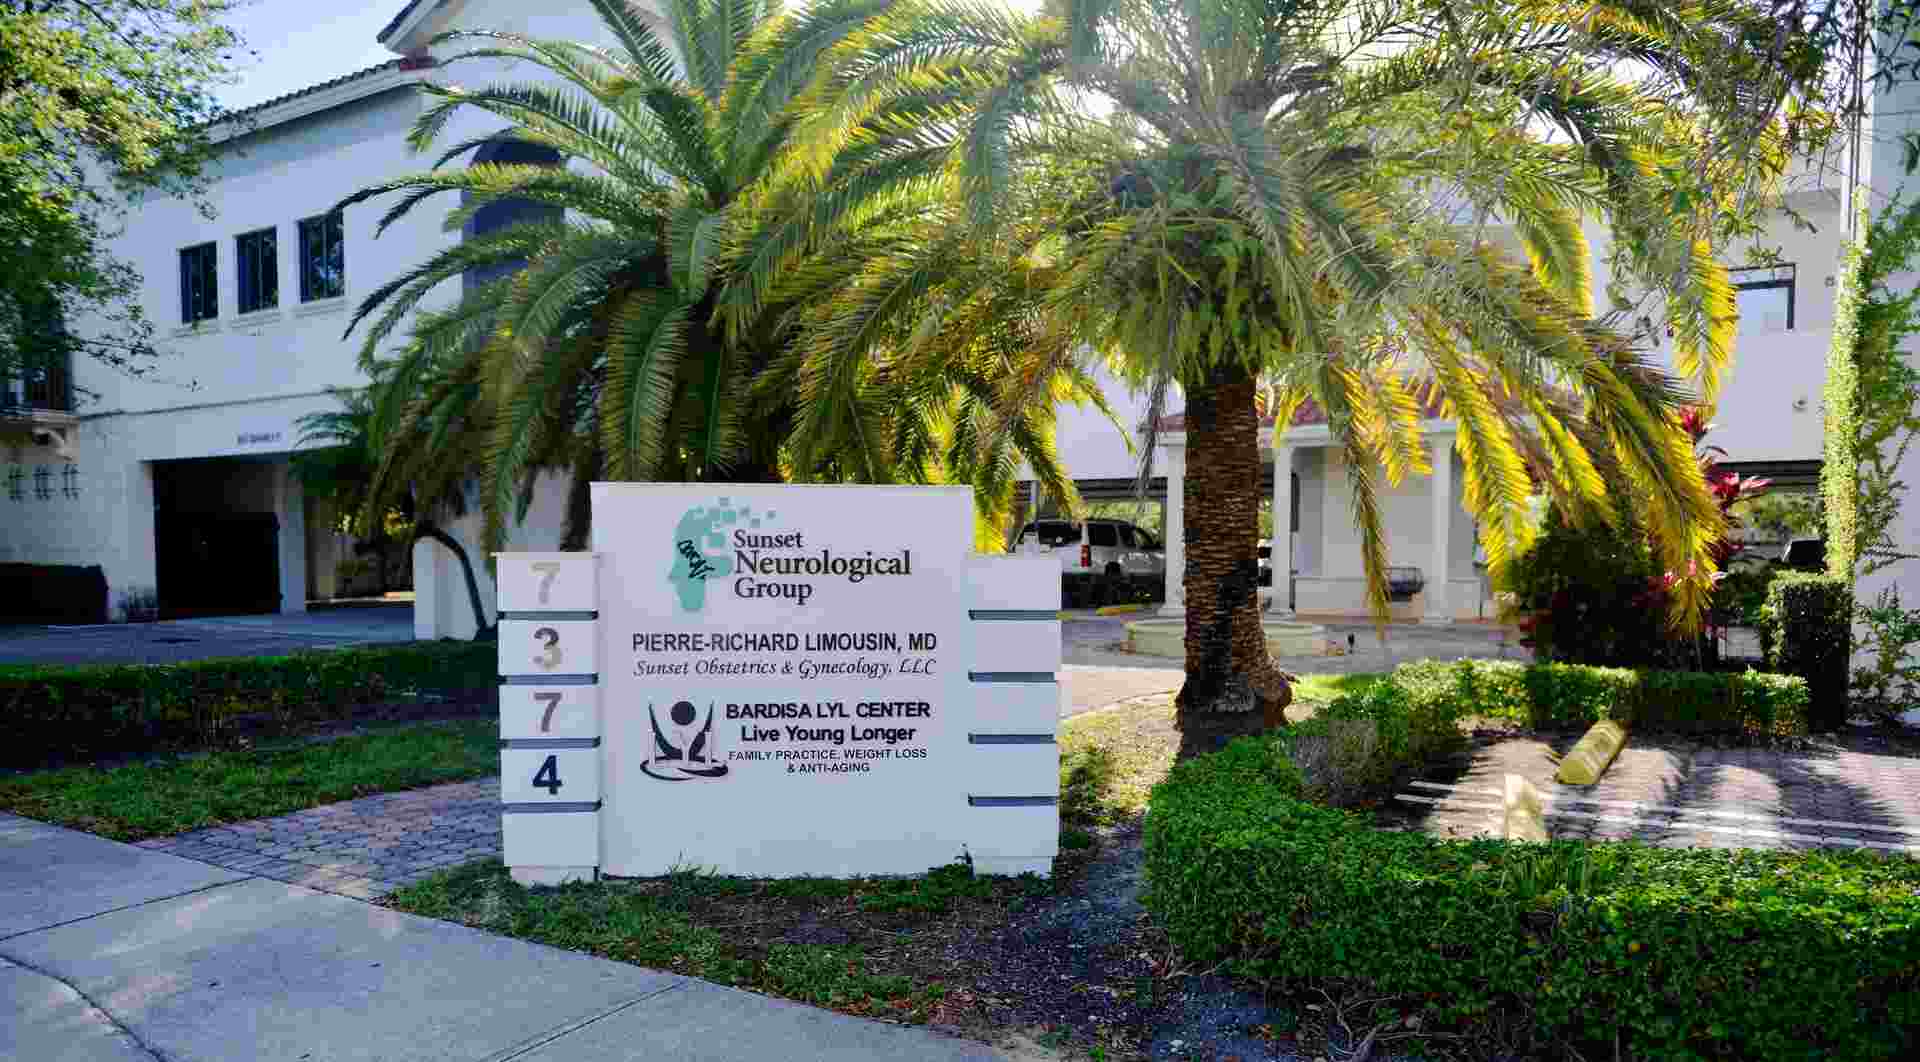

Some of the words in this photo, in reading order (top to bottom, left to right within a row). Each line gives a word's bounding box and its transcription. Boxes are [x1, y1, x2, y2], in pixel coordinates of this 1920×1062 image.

[733, 528, 804, 549] Sunset
[733, 549, 912, 583] Neurological
[530, 562, 561, 604] 7
[734, 576, 813, 606] Group
[533, 627, 562, 672] 3
[632, 633, 799, 651] PIERRE-RICHARD
[805, 633, 901, 654] LIMOUSIN,
[908, 633, 937, 651] MD
[633, 659, 689, 676] Sunset
[695, 657, 777, 675] Obstetrics
[781, 661, 793, 675] &
[899, 657, 937, 675] LLC
[533, 692, 562, 733] 7
[726, 702, 812, 719] BARDISA
[816, 702, 848, 719] LYL
[856, 701, 931, 719] CENTER
[741, 725, 780, 743] Live
[785, 725, 845, 745] Young
[851, 724, 917, 745] Longer
[728, 750, 772, 761] FAMILY
[843, 749, 890, 760] WEIGHT
[895, 748, 928, 759] LOSS
[532, 755, 563, 795] 4
[786, 763, 796, 774] &
[799, 762, 871, 774] ANTI-AGING
